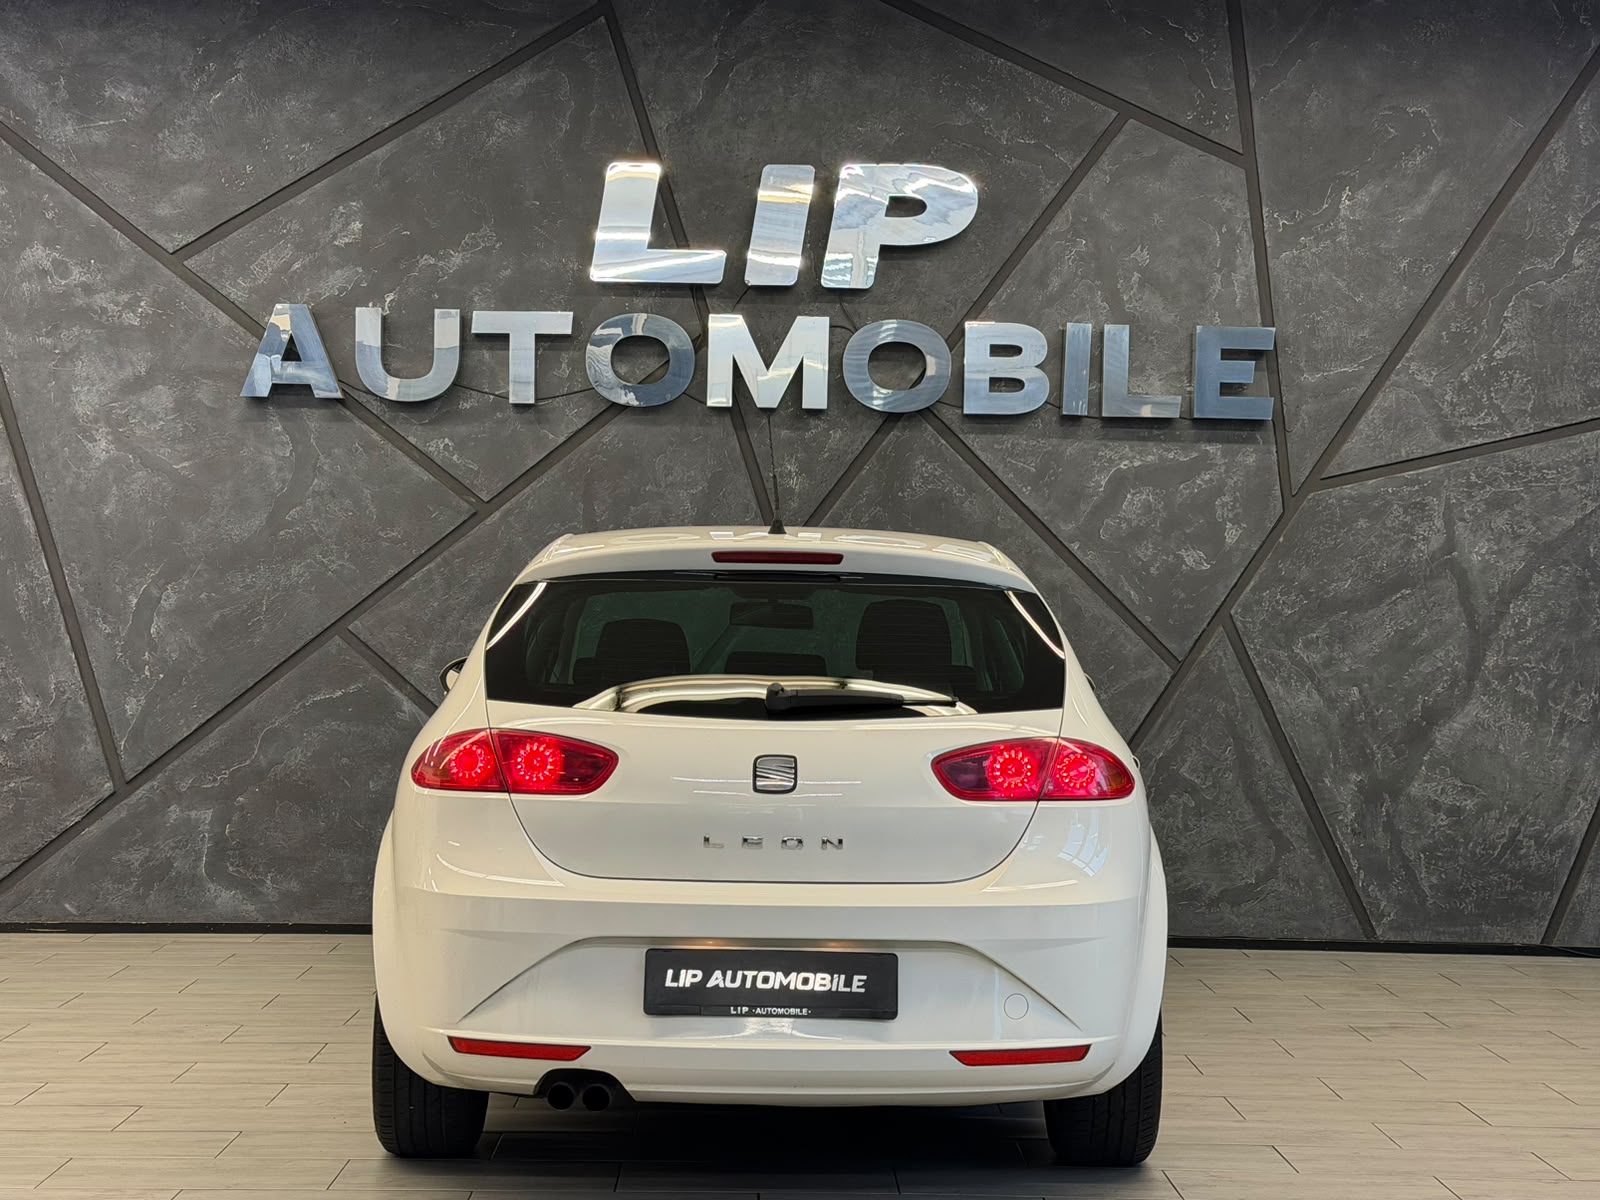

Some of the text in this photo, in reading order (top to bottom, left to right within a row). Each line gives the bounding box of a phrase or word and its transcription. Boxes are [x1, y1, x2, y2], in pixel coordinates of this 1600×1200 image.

[588, 160, 979, 291] LIP
[240, 302, 1277, 420] AUTOMOBILE
[703, 834, 844, 850] LEON
[665, 969, 867, 993] LIP AUTOMOBILE
[730, 1006, 749, 1015] LIP
